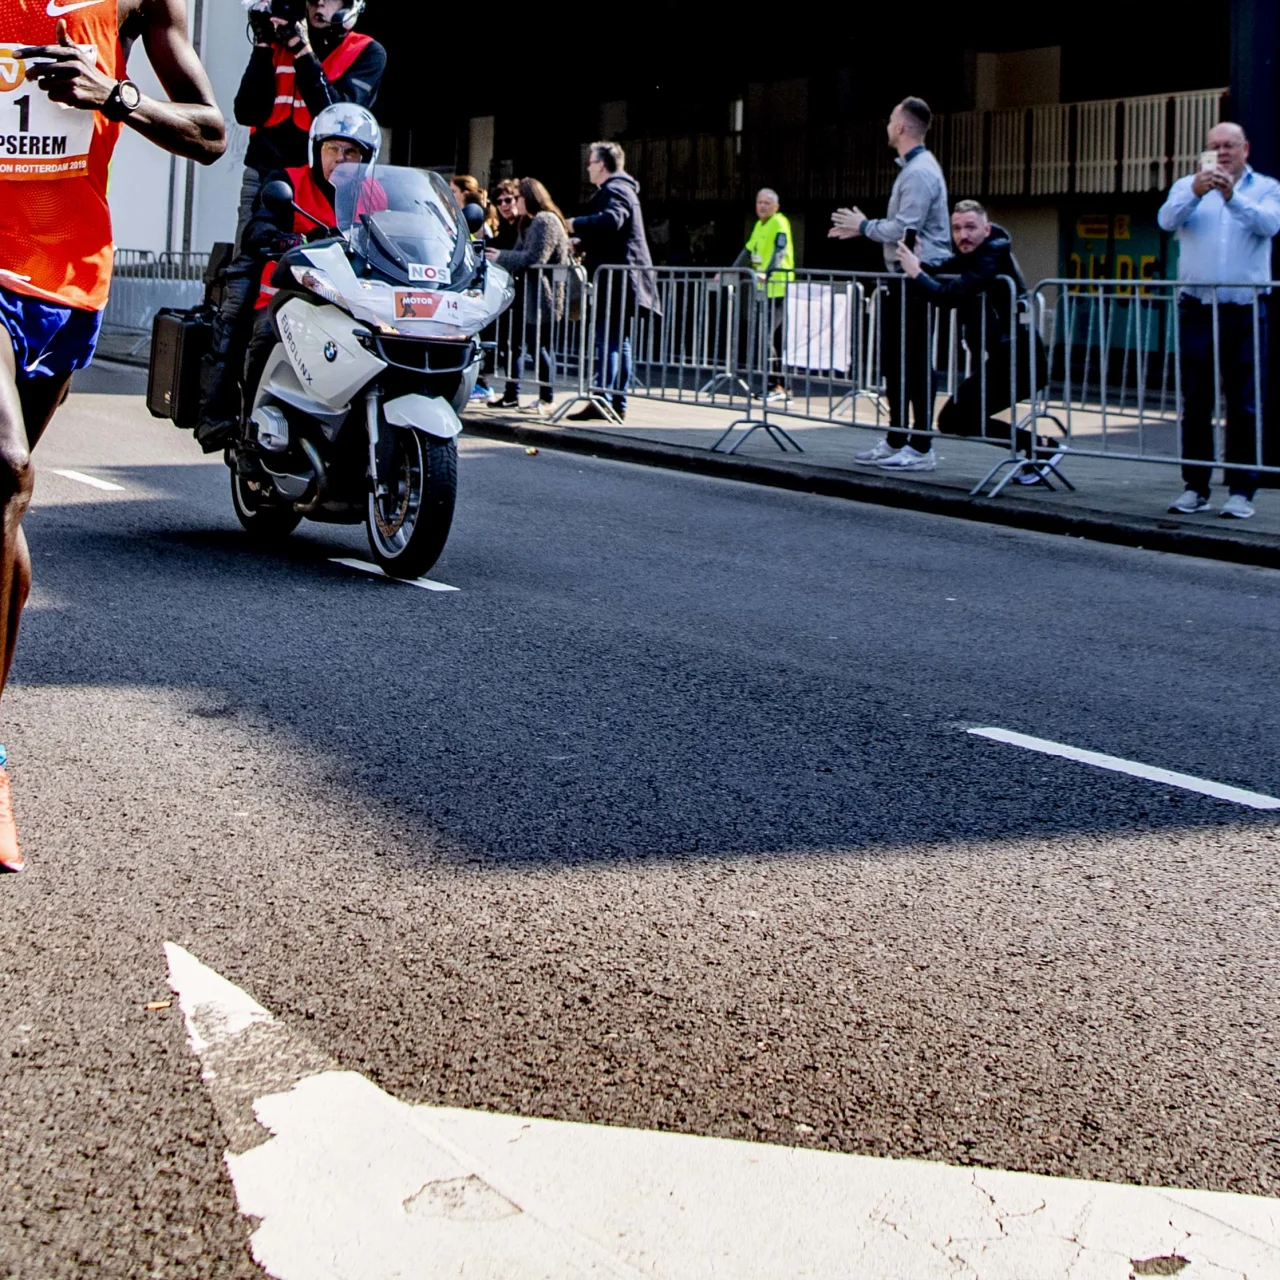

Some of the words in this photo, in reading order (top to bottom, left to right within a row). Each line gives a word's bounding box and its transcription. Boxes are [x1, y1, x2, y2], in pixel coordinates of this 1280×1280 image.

[13, 95, 30, 132] 1
[15, 163, 69, 173] ROTTERDAM
[70, 160, 87, 170] 2019
[412, 267, 447, 280] NOS
[402, 297, 433, 305] MOTOR
[446, 300, 458, 310] 14
[281, 314, 313, 386] EUROLINX
